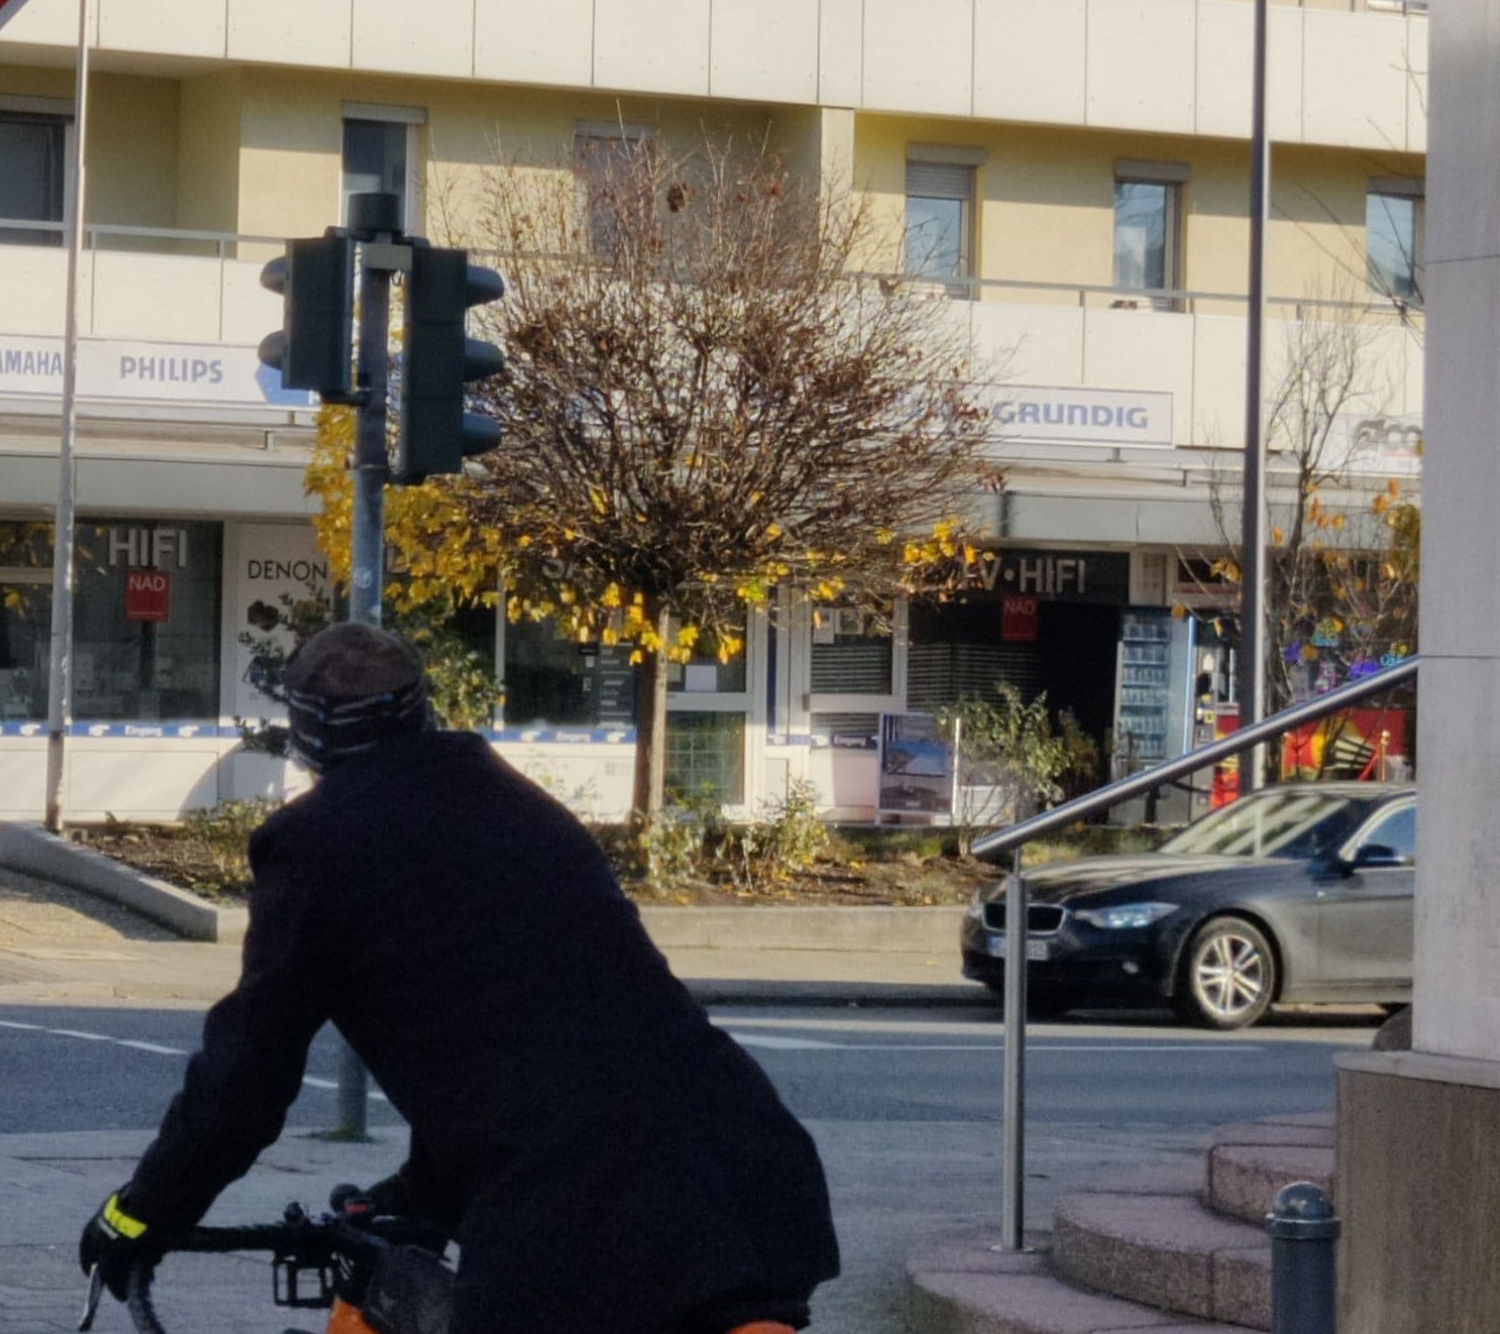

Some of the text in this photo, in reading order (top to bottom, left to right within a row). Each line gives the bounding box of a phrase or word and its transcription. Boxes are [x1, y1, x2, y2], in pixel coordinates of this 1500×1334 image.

[119, 355, 223, 383] PHILIPS
[992, 400, 1148, 429] GRUNDIG
[109, 528, 187, 567] HIFI
[248, 560, 328, 581] DENON
[128, 576, 166, 591] NAD
[1004, 598, 1037, 615] NAD
